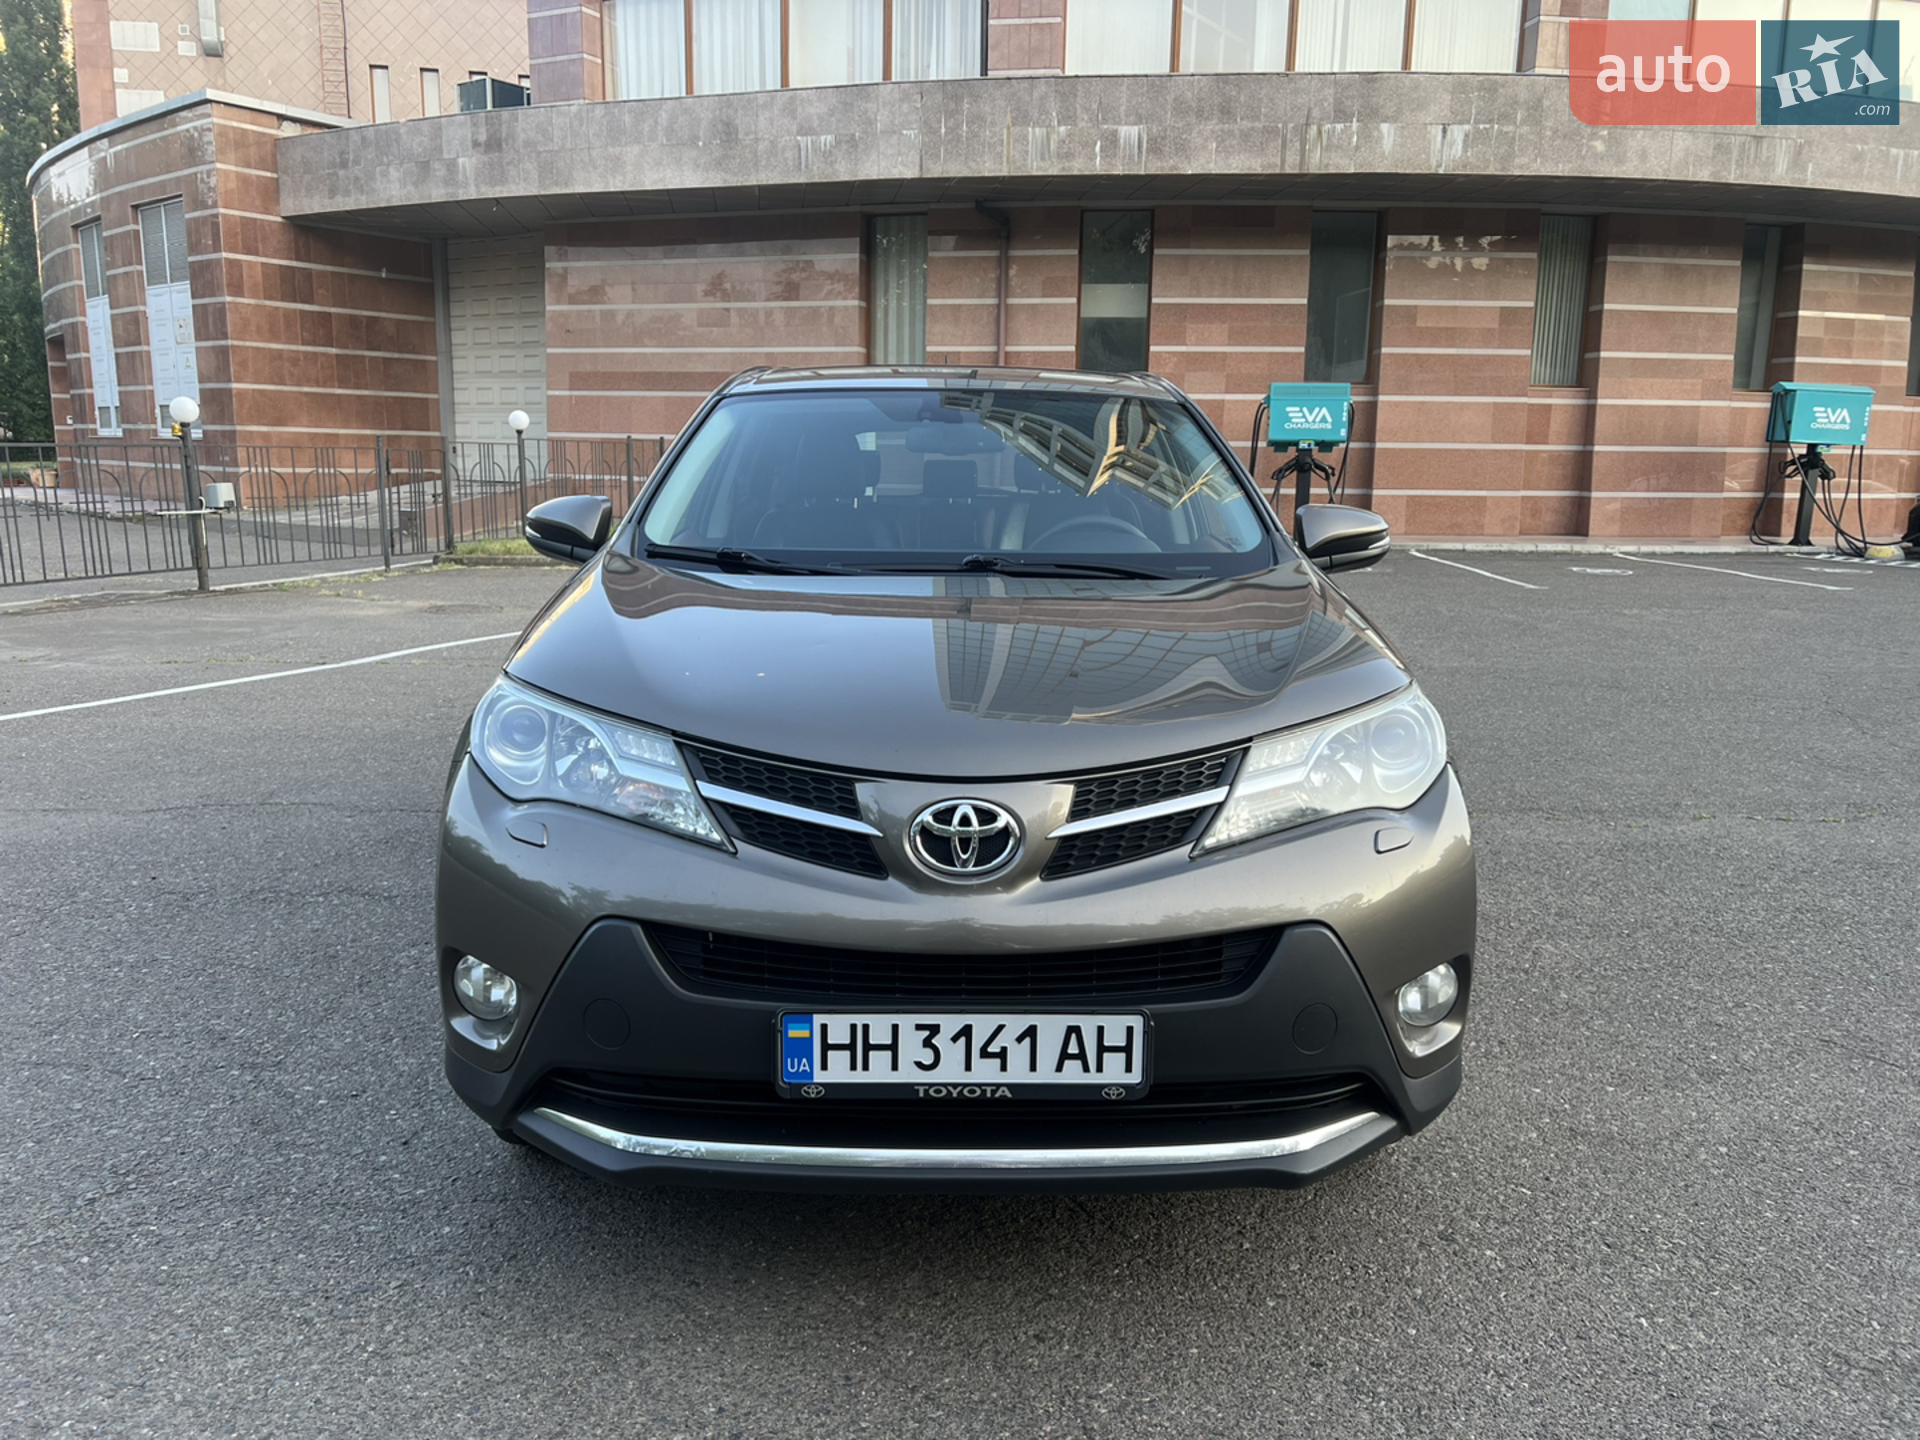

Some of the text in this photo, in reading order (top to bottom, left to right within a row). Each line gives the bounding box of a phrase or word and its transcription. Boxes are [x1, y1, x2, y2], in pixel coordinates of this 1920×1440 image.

[1285, 406, 1333, 423] EVA
[1812, 406, 1852, 424] EVA
[1284, 422, 1332, 430] CHARGERS
[820, 1022, 1135, 1074] HH 3141 AH
[787, 1057, 811, 1073] UA
[914, 1085, 1013, 1098] TOYOTA
